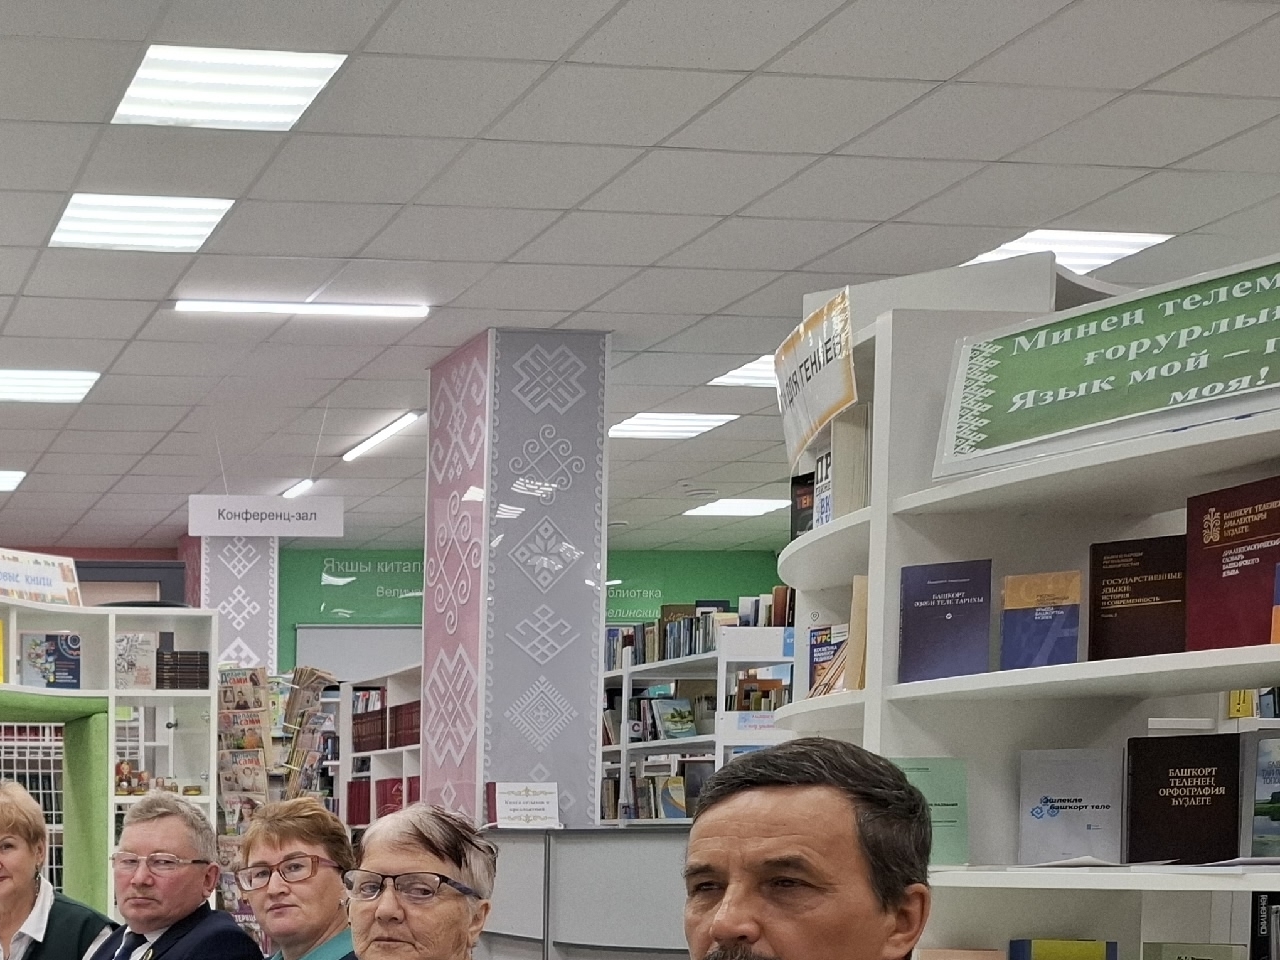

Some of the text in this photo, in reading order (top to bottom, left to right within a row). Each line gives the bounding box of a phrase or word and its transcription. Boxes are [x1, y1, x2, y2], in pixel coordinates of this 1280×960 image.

[1011, 308, 1144, 356] Минең
[1007, 375, 1116, 413] Язык
[1128, 349, 1210, 385] мой
[1168, 366, 1269, 405] моя!
[217, 508, 317, 522] Конференц-зал
[377, 561, 423, 573] китап
[607, 587, 662, 598] блиотека
[1158, 786, 1226, 797] ОРФОГРАФИЯ
